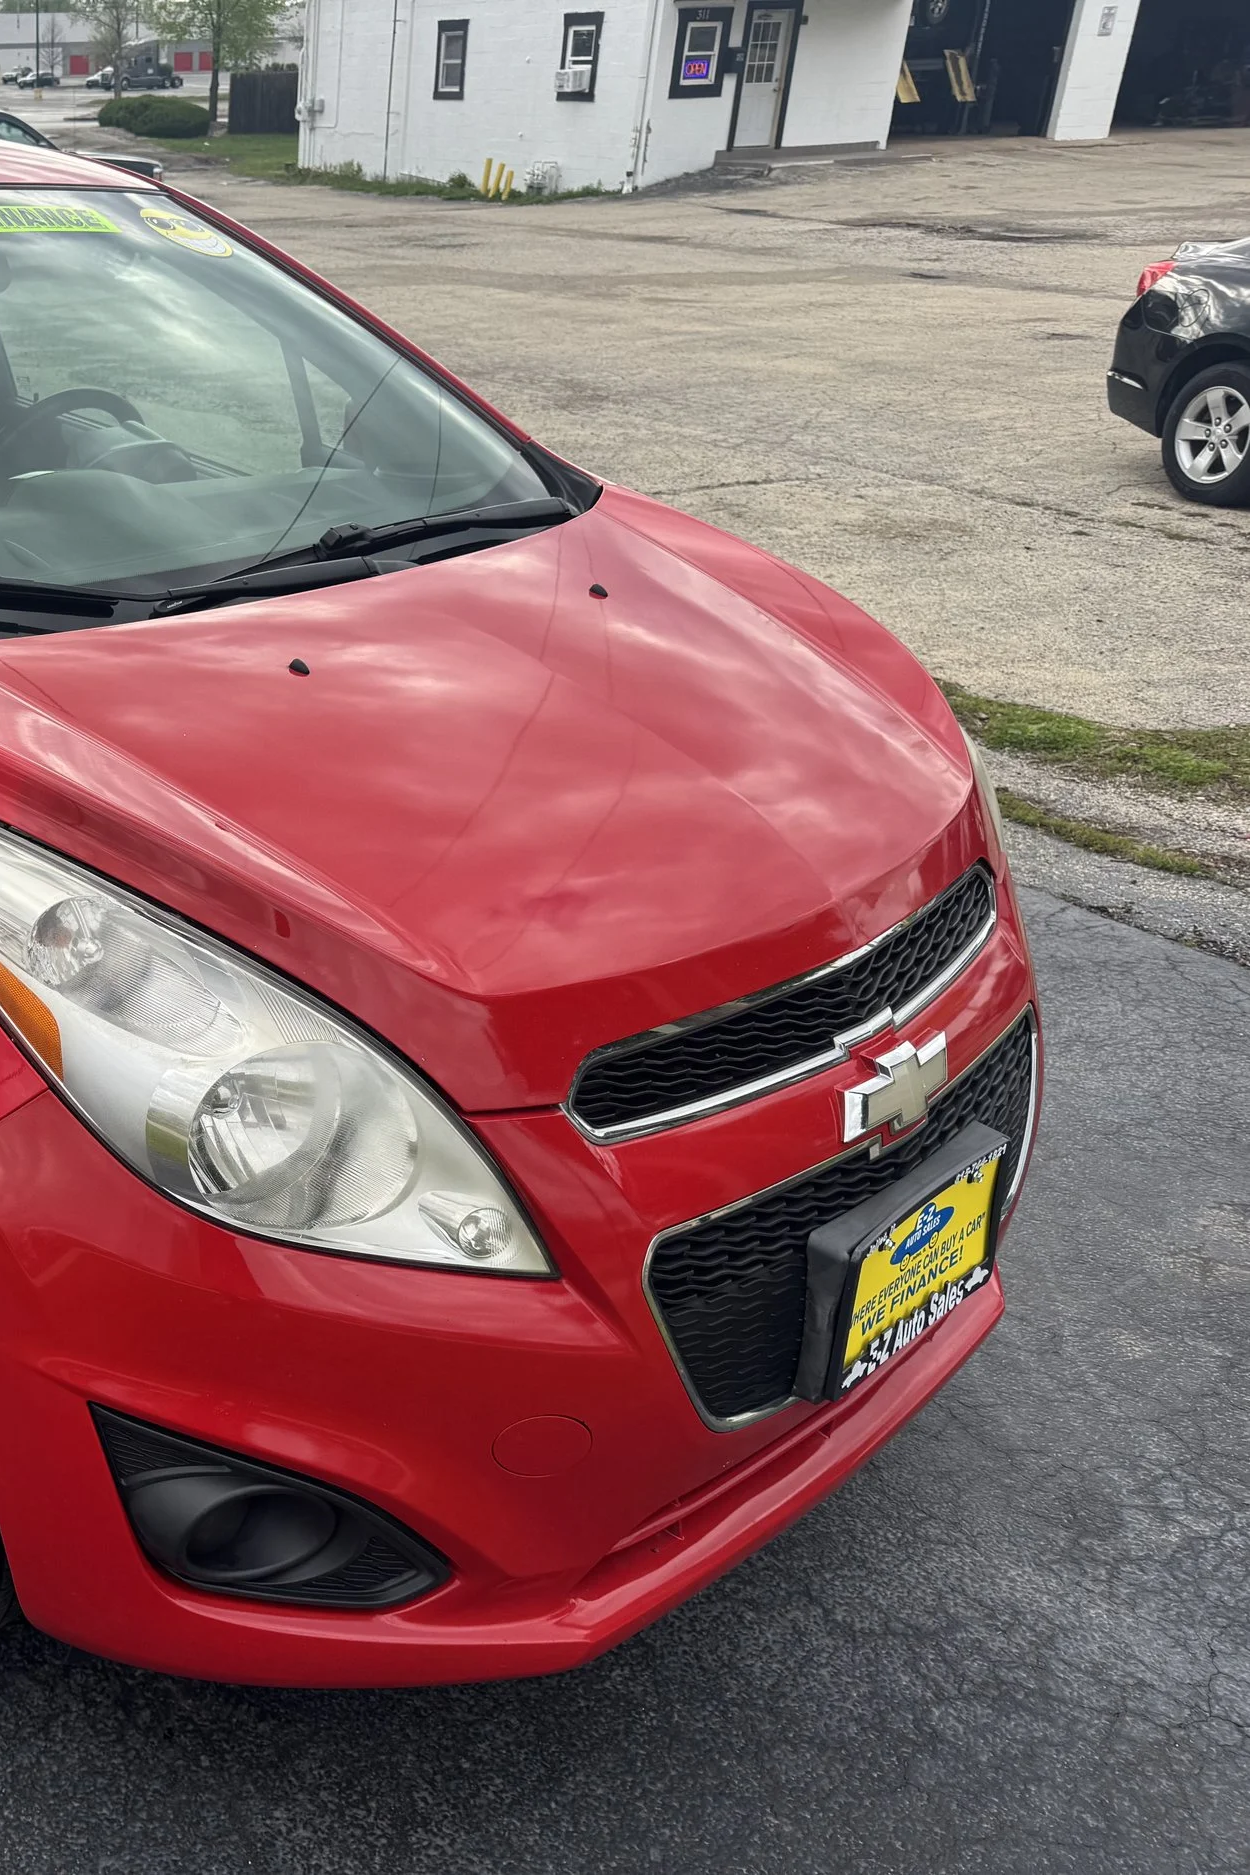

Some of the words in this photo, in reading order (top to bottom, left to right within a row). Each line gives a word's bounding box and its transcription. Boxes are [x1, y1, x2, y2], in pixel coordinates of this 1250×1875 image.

[696, 9, 710, 20] 311
[685, 62, 707, 76] OPEN
[905, 1230, 922, 1250] AUTO
[922, 1215, 941, 1236] SALES
[916, 1205, 936, 1231] E-Z
[877, 1260, 922, 1306] EVERYONE
[923, 1247, 940, 1270] CAN
[940, 1231, 958, 1257] BUY
[958, 1227, 965, 1243] A
[861, 1305, 887, 1336] WE
[890, 1245, 964, 1314] FINANCE!
[867, 1327, 893, 1376] E-Z
[892, 1308, 926, 1355] Auto
[928, 1280, 965, 1326] Sales
